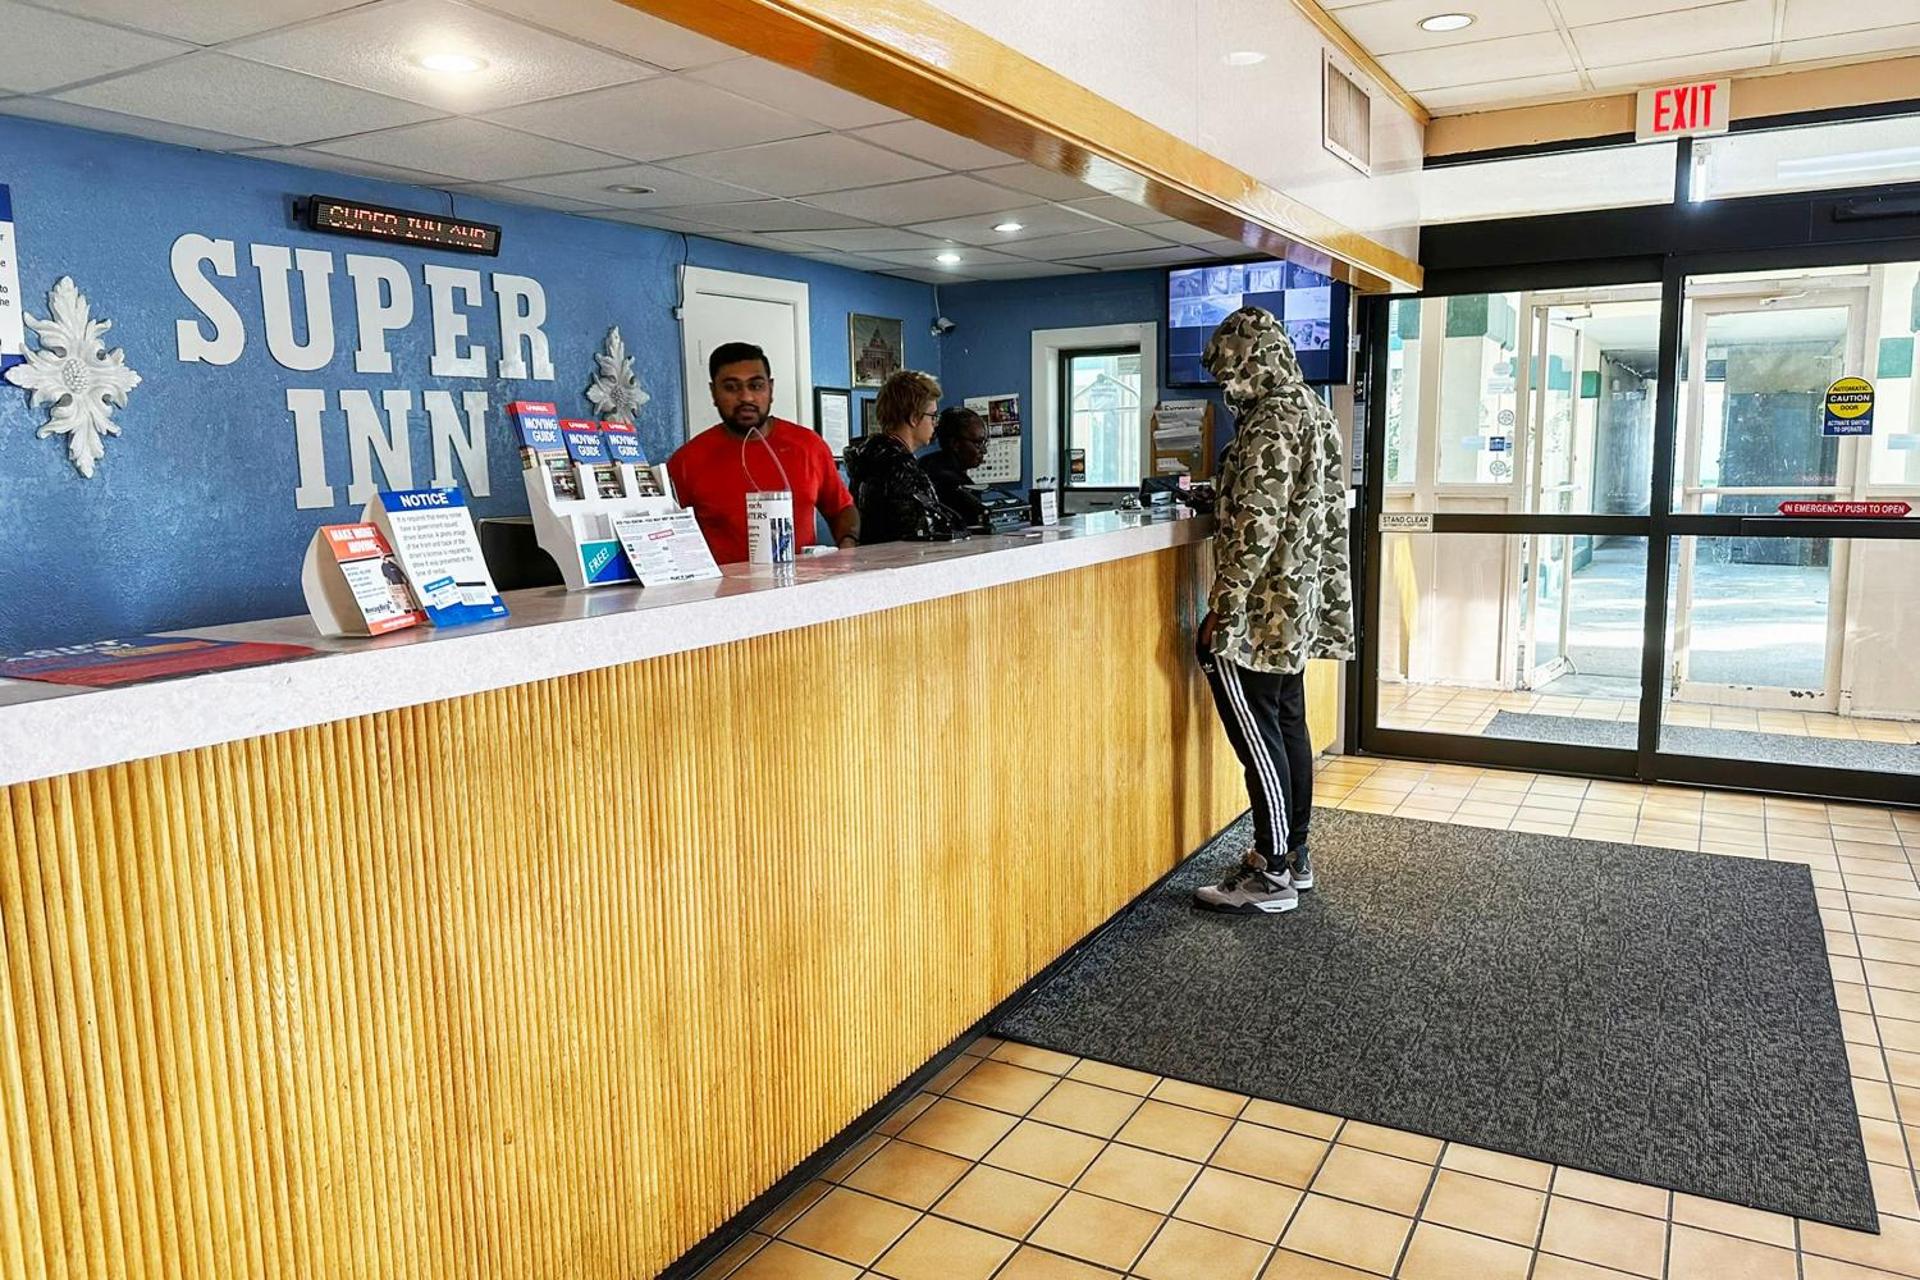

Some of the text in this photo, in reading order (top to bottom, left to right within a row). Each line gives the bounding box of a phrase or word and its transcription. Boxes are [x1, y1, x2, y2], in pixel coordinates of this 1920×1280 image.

[1654, 84, 1717, 132] EXIT
[329, 205, 398, 236] SUPER
[406, 217, 441, 242] INN
[170, 233, 555, 381] SUPER
[1829, 394, 1870, 402] CAUTION
[524, 417, 557, 430] MOVING
[532, 430, 557, 442] GUIDE
[569, 434, 600, 446] MOVING
[609, 434, 639, 446] MOVING
[286, 388, 491, 509] INN
[578, 446, 601, 457] GUIDE
[617, 446, 640, 457] GUIDE
[399, 492, 449, 508] NOTICE
[1784, 504, 1905, 514] IN EMERGENCY PUSH TO OPEN
[588, 547, 610, 573] FREE!
